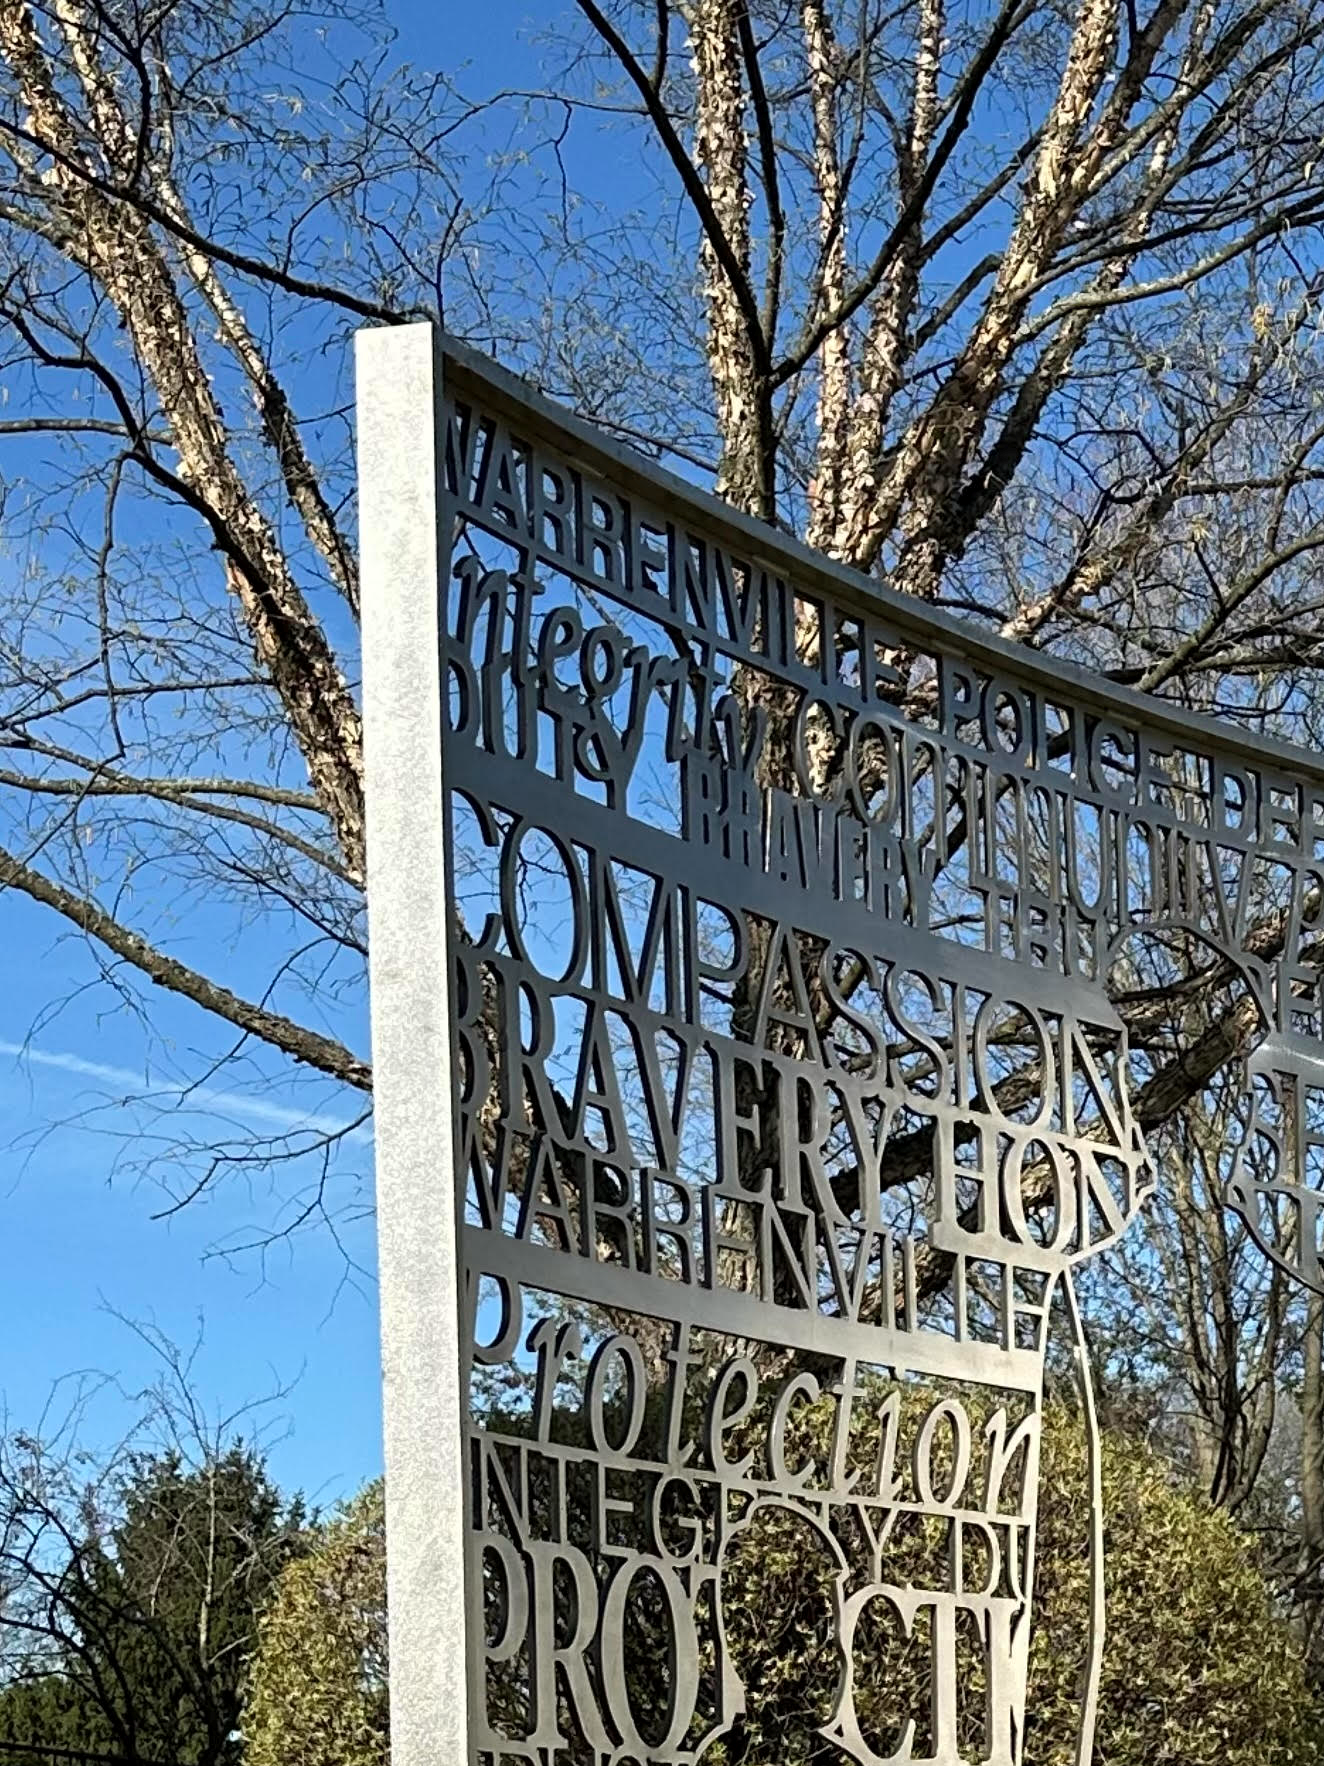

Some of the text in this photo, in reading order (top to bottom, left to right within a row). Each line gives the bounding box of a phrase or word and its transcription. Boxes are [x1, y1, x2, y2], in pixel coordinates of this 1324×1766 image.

[941, 656, 1182, 818] POLICE
[447, 785, 1130, 1148] COMPASSION
[466, 1268, 1042, 1520] Protection
